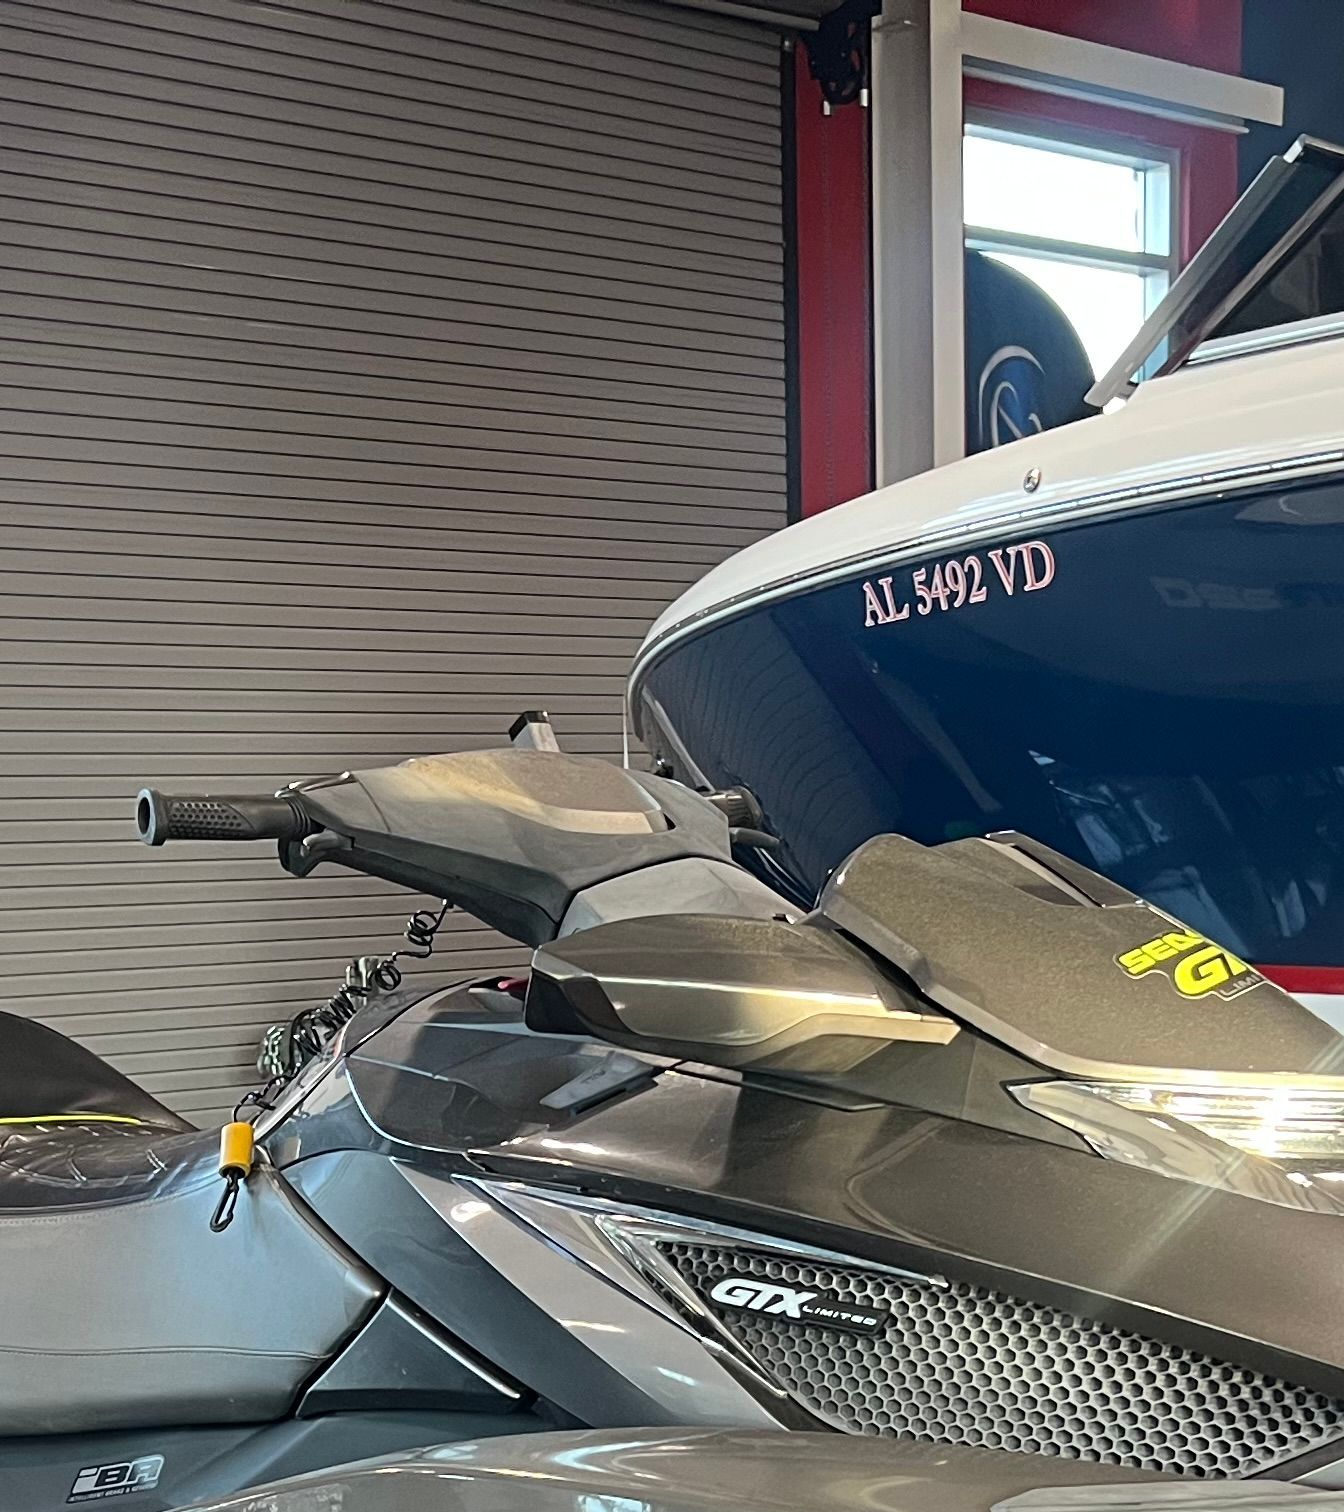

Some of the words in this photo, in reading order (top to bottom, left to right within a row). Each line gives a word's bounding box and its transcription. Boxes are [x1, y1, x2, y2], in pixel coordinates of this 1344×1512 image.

[862, 577, 910, 627] AL
[913, 555, 987, 616] 5492
[988, 540, 1055, 596] VD
[1119, 930, 1205, 975] SEA
[711, 1278, 818, 1319] GTX
[802, 1306, 877, 1326] LIMITED
